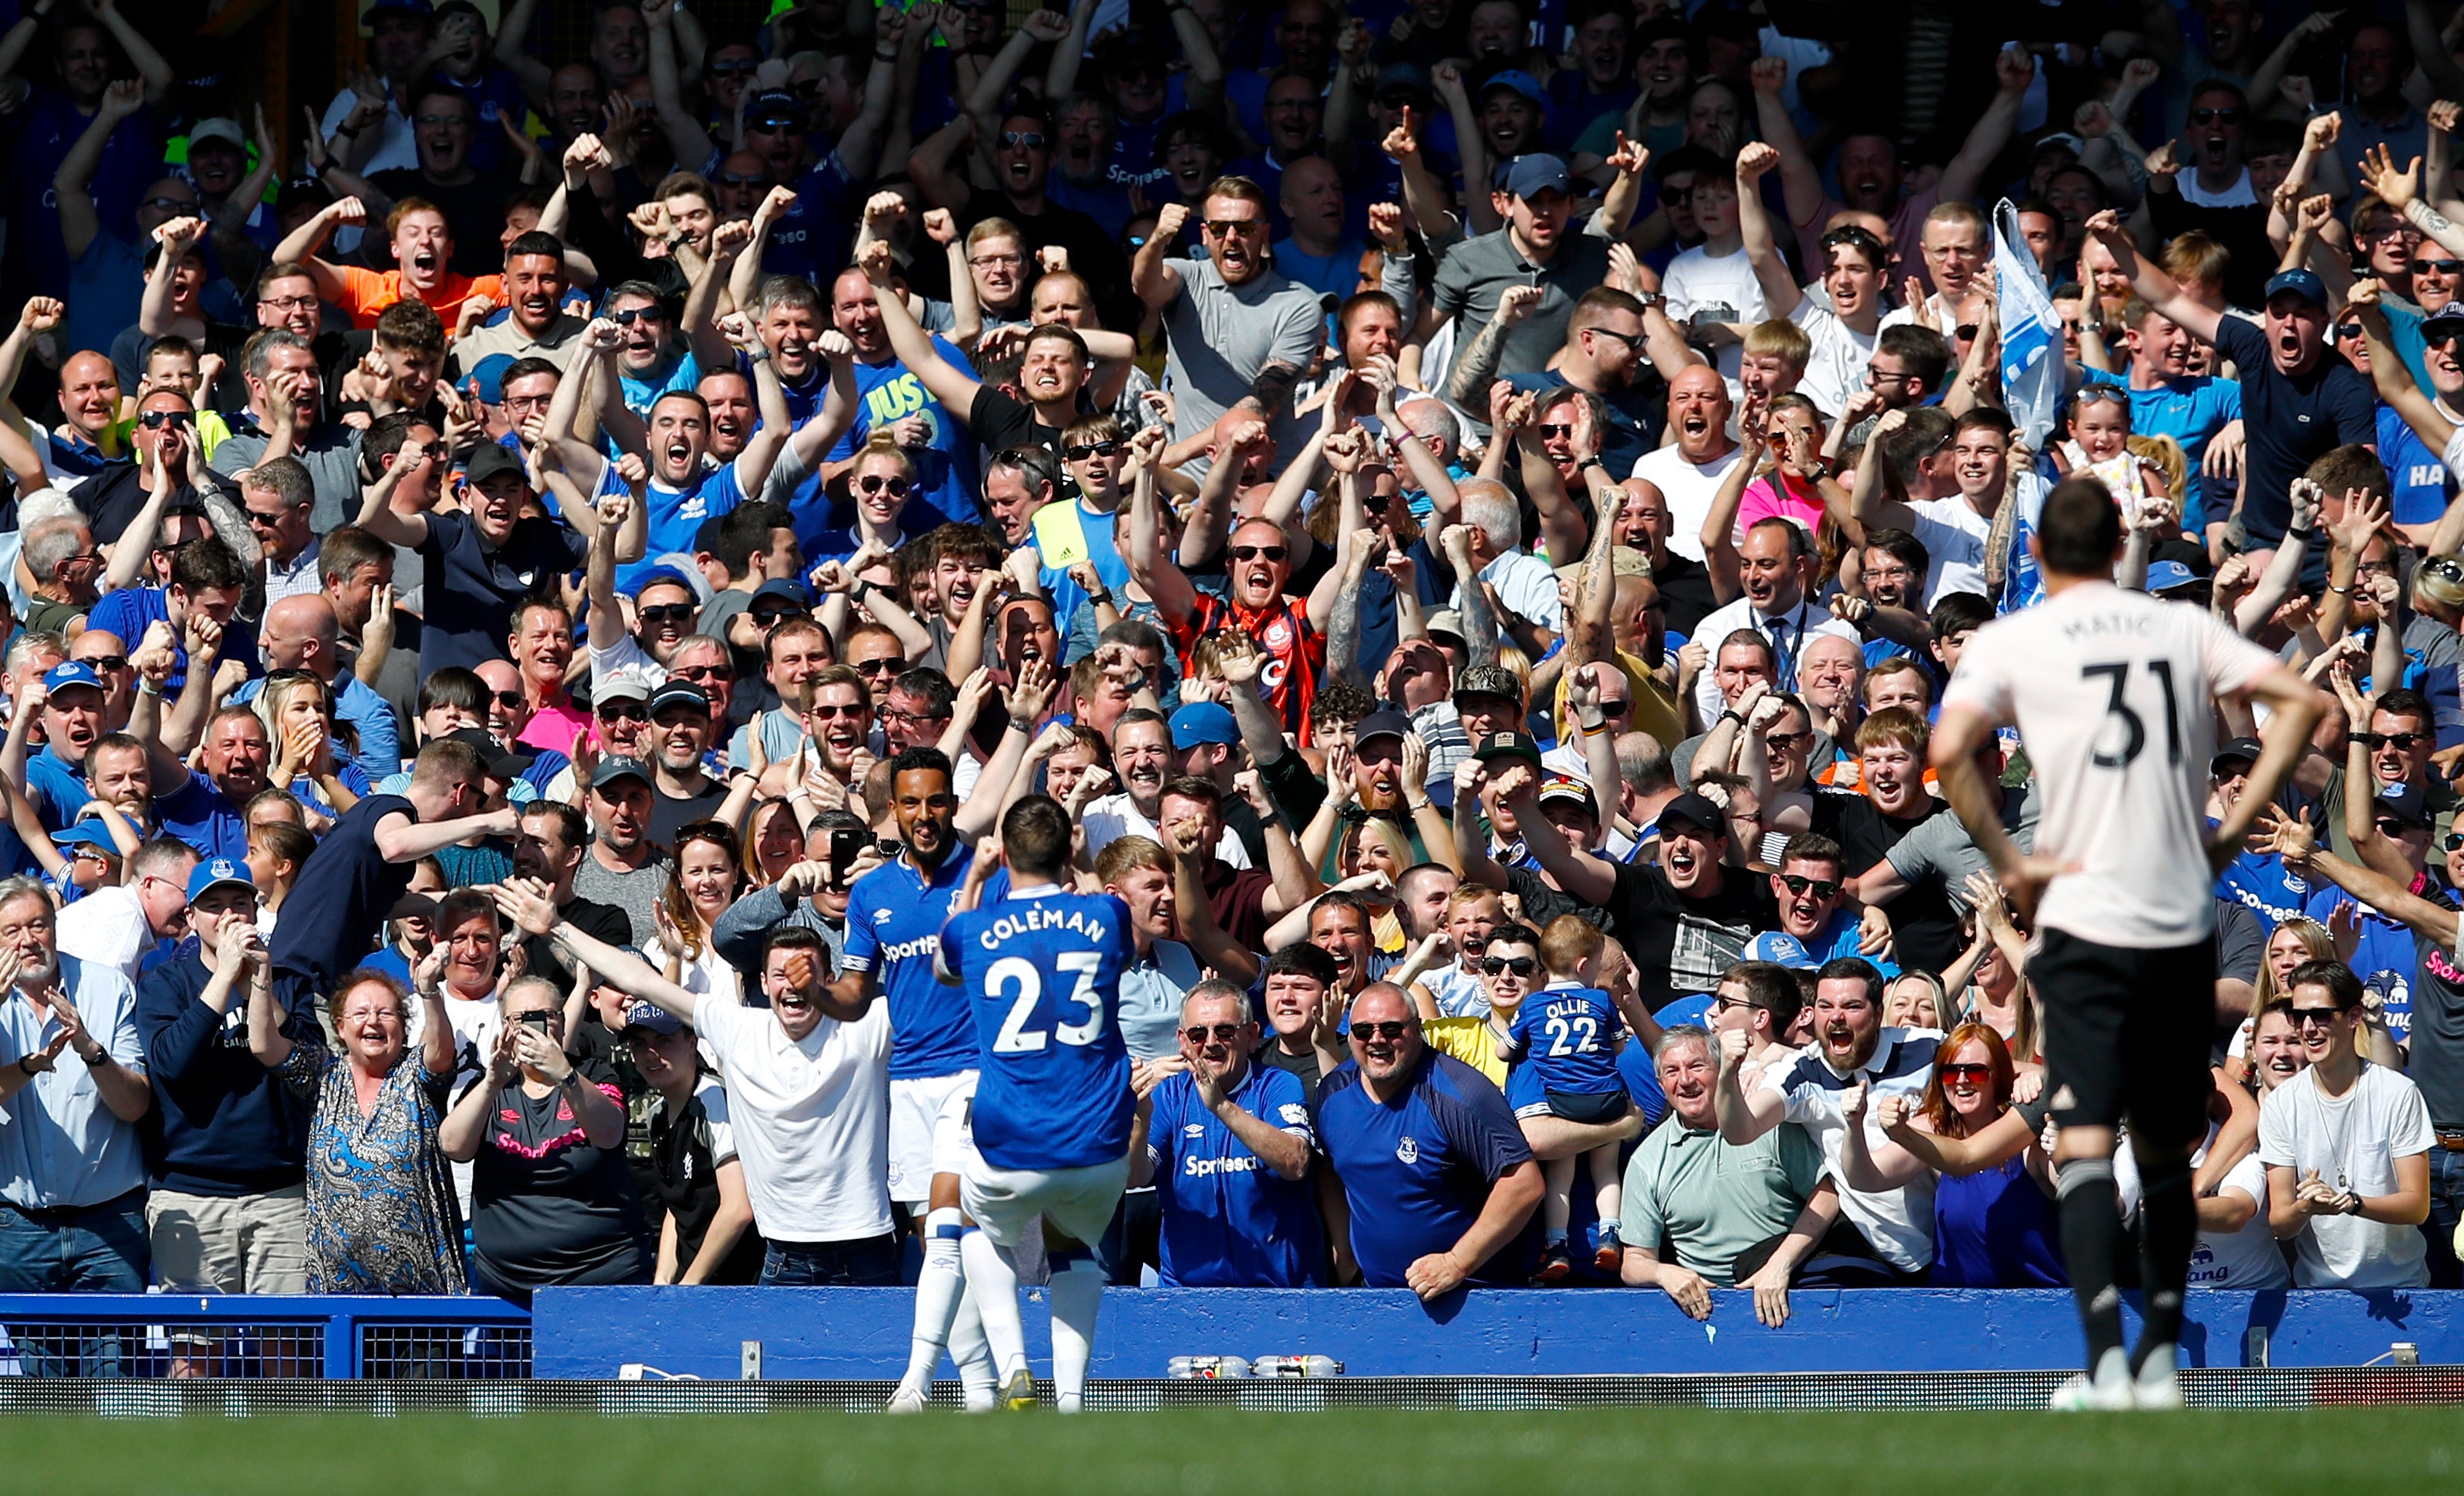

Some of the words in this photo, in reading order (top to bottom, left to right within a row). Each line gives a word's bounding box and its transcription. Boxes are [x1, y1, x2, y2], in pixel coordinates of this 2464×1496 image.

[2082, 660, 2180, 768] 31
[880, 934, 939, 964] SportP
[980, 910, 1105, 950] COLEMAN
[984, 951, 1104, 1052] 23
[1546, 999, 1590, 1018] OLLIE
[1545, 1018, 1598, 1056] 22
